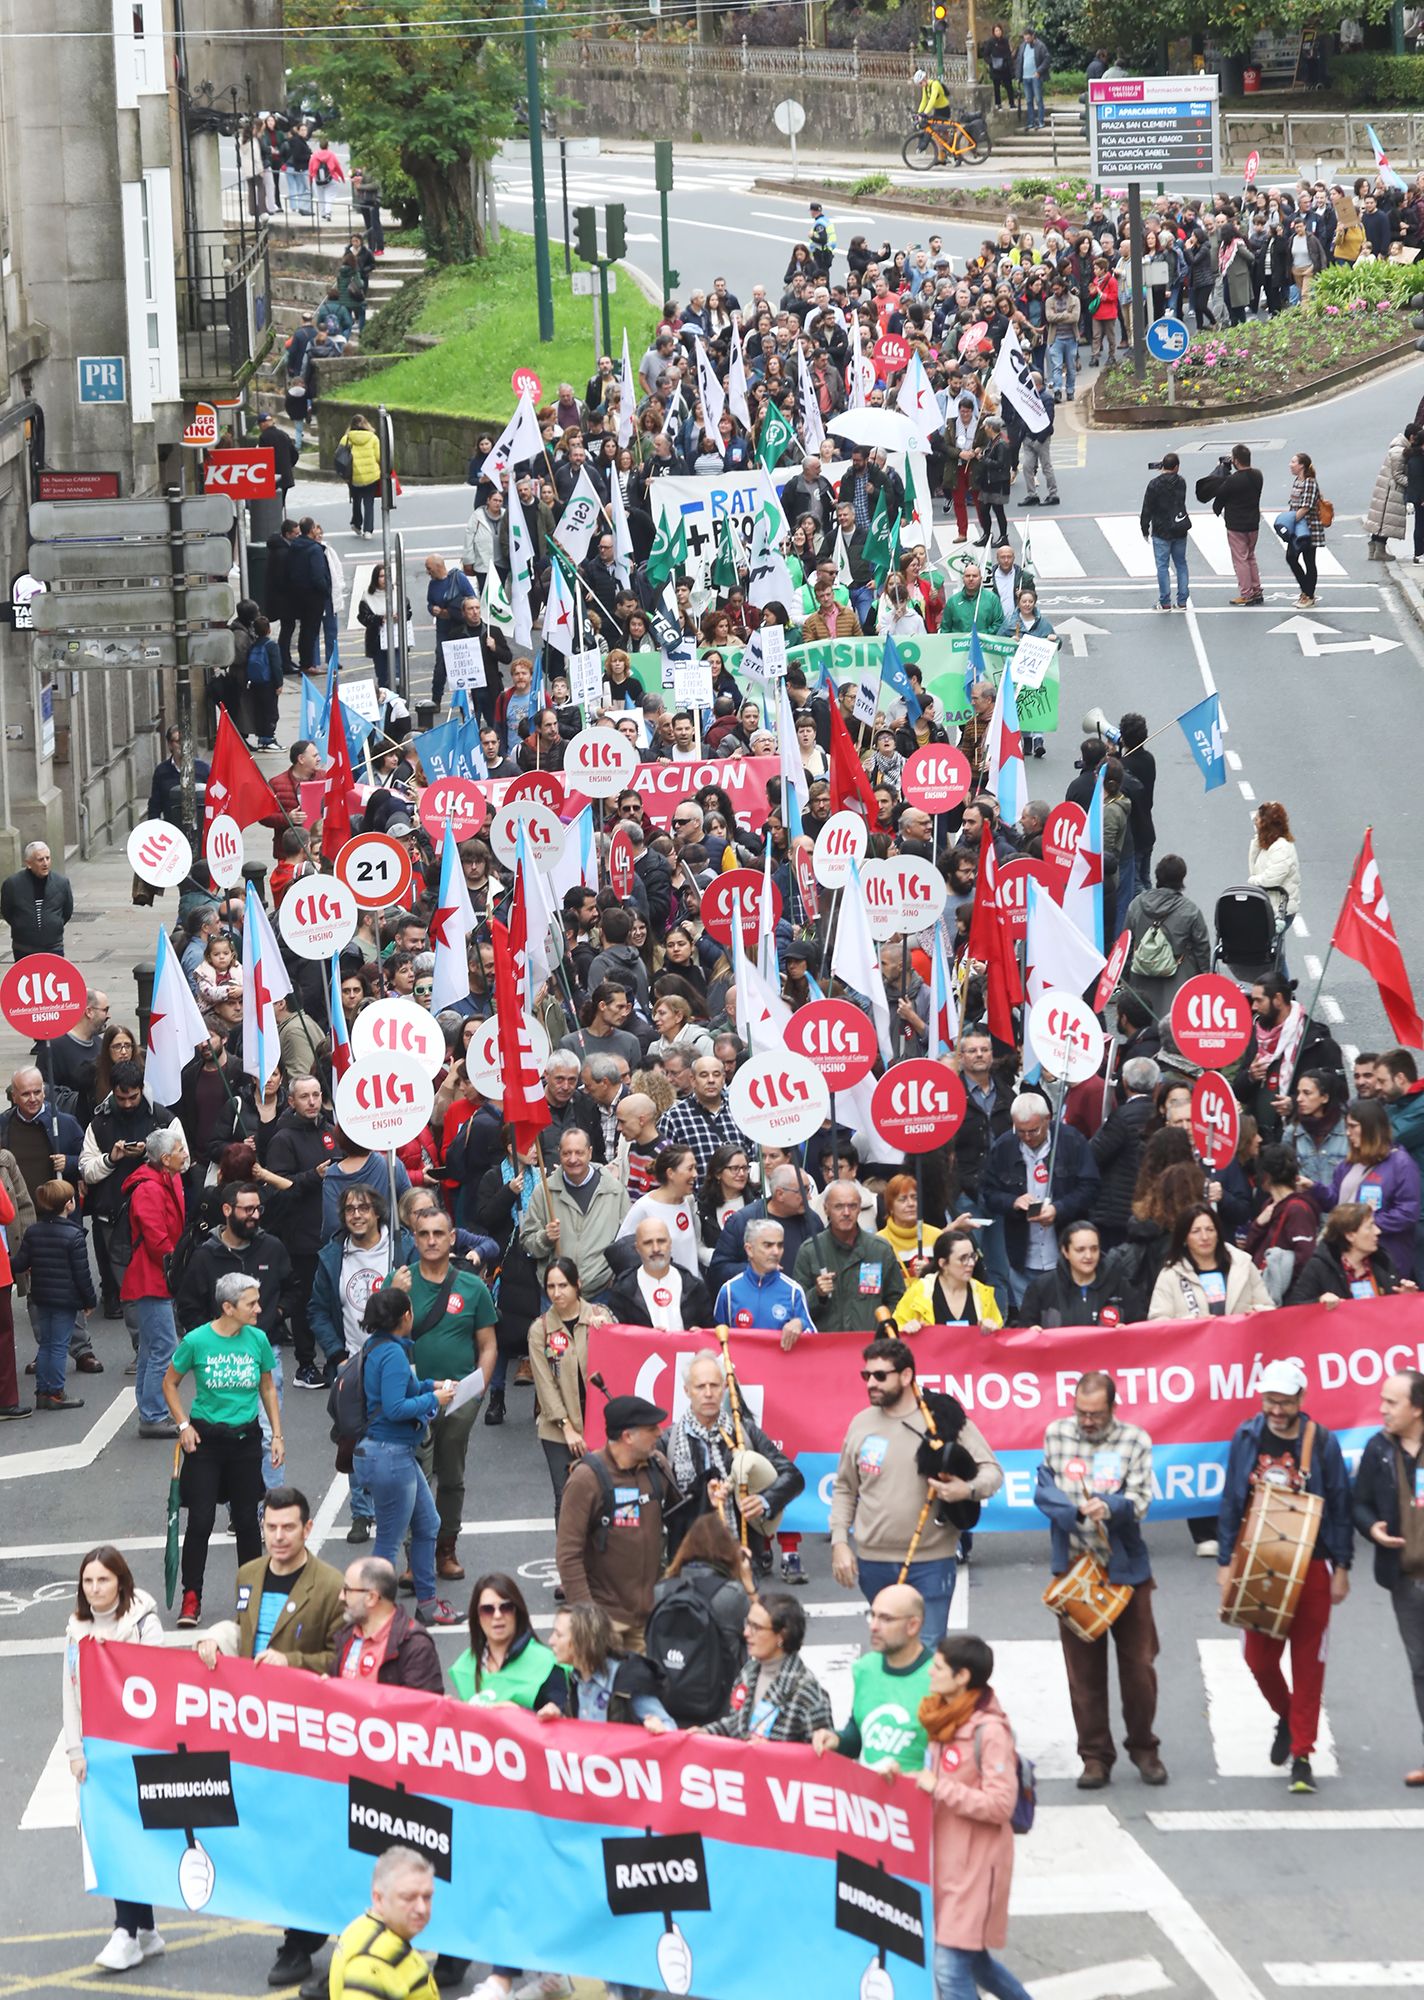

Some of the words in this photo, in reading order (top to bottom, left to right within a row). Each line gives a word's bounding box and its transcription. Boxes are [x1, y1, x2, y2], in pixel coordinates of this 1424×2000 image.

[1101, 122, 1125, 130] PRAZA
[1126, 121, 1141, 129] SAN
[1142, 119, 1178, 128] CLEMENTE
[1118, 107, 1178, 116] APARCAMIENTOS
[1147, 135, 1157, 143] DE
[1118, 163, 1133, 171] DAS
[1134, 162, 1163, 171] HORTAS
[84, 364, 118, 387] PR
[204, 463, 268, 485] KFC
[15, 617, 33, 629] BE
[652, 608, 681, 643] TEG
[794, 641, 921, 673] ENSINO
[856, 698, 874, 717] STEG
[579, 743, 622, 768] CIG
[588, 775, 612, 783] ENSINO
[916, 758, 958, 785] CIG
[924, 791, 948, 800] ENSINO
[505, 818, 551, 844] CG
[826, 828, 857, 855] CIG
[137, 832, 173, 868] CIG
[214, 831, 237, 859] CIG
[356, 860, 389, 882] 21
[866, 877, 894, 906] CIG
[898, 872, 931, 901] IG
[294, 892, 342, 926] CIG
[901, 908, 920, 918] SINO
[308, 930, 334, 944] ENSINO
[17, 970, 71, 1006] CIG
[31, 1011, 60, 1023] ENSINO
[1187, 994, 1237, 1029] CIG
[373, 1017, 427, 1055] CIG
[801, 1018, 860, 1055] CIG
[355, 1072, 414, 1111] CIG
[748, 1071, 809, 1110] CIG
[891, 1079, 949, 1116] CIG
[371, 1116, 404, 1131] ENSINO
[768, 1114, 801, 1129] ENSINO
[904, 1122, 935, 1134] ENSINO
[914, 1371, 1041, 1411] ENOS
[863, 1721, 917, 1756] CSIF
[121, 1675, 158, 1719] O
[175, 1682, 528, 1781] PROFESORADO
[545, 1747, 663, 1803] NON
[680, 1763, 747, 1817] SE
[766, 1776, 915, 1853] VENDE
[139, 1778, 231, 1801] RETRIBUCIÓNS
[349, 1802, 450, 1855] HORARIOS
[615, 1857, 699, 1890] RATIOS
[837, 1881, 925, 1938] BUROCRACIA
